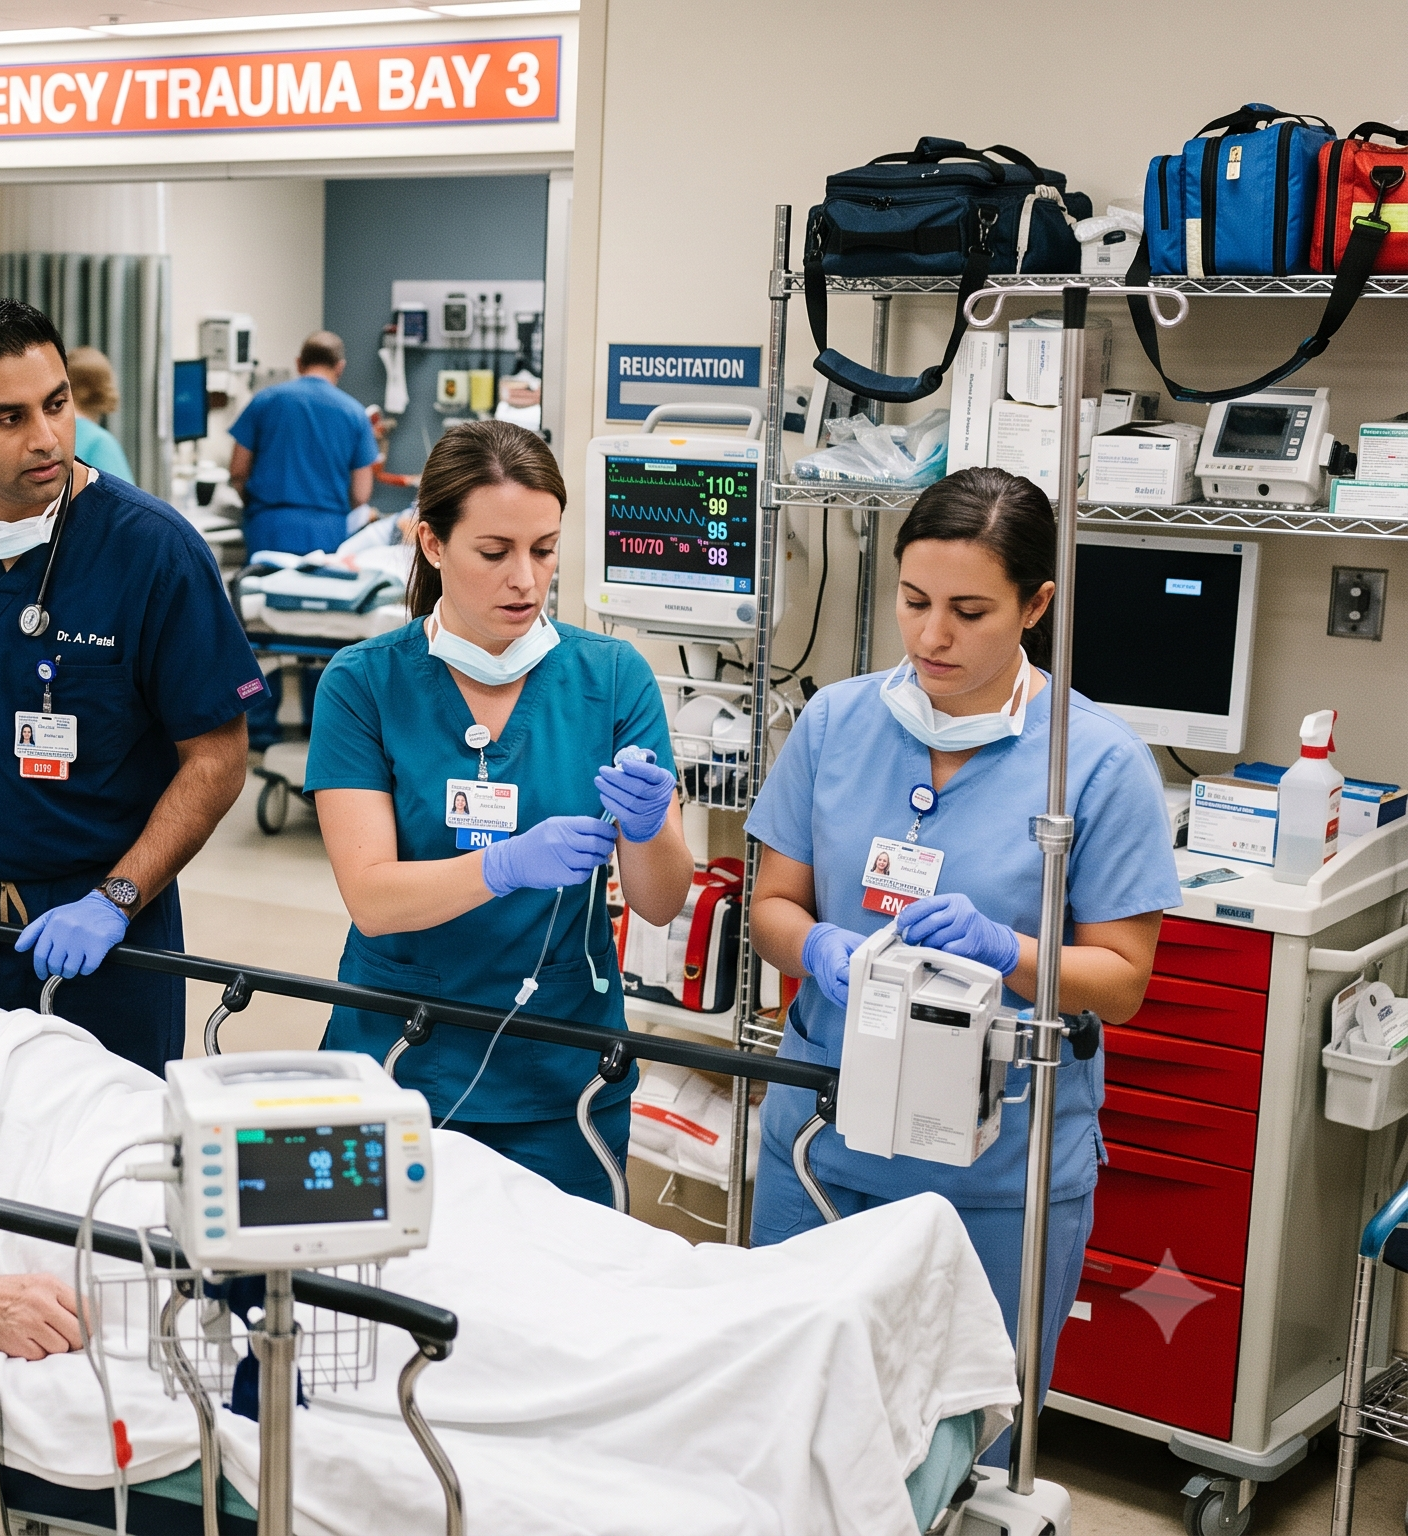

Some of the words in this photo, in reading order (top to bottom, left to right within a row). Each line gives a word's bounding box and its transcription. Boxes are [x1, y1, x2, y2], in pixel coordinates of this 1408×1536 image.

[378, 53, 491, 112] BAY
[504, 51, 541, 107] 3
[619, 356, 745, 379] REUSCITATION
[706, 476, 735, 495] 110
[708, 498, 728, 515] 99
[620, 537, 664, 555] 110/70
[708, 547, 728, 566] 98
[56, 630, 72, 643] Dr.
[73, 632, 86, 644] A.
[470, 831, 493, 847] RN
[880, 894, 905, 915] RN
